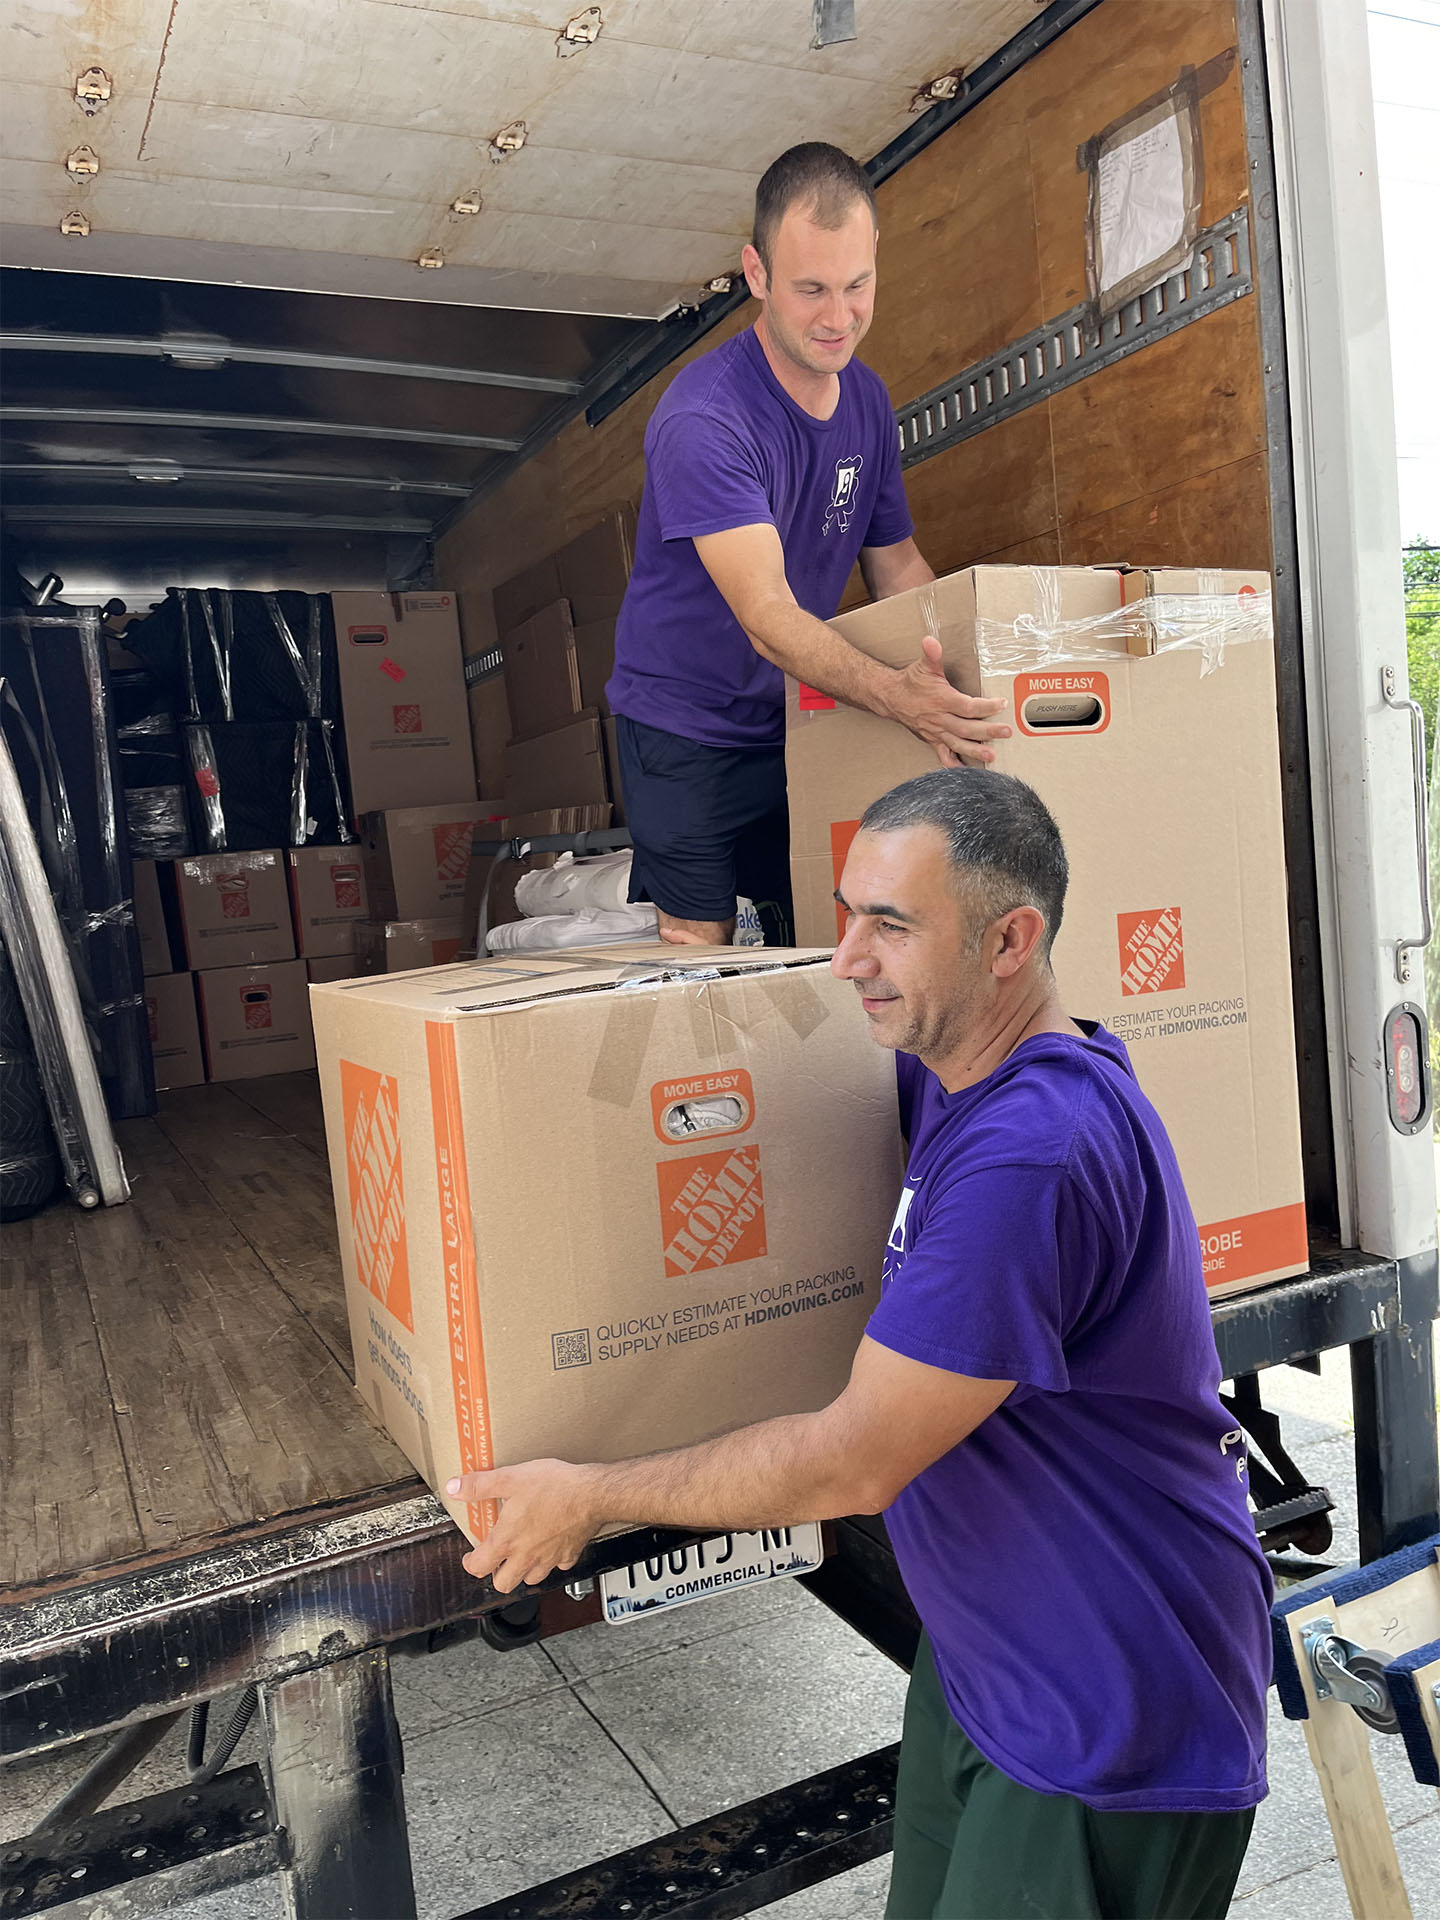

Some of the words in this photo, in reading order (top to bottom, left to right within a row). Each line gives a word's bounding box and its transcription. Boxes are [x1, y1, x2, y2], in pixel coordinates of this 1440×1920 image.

[1029, 677, 1063, 691] MOVE
[1065, 677, 1095, 690] EASY
[1036, 704, 1057, 713] PUSH
[1057, 703, 1079, 712] HERE
[1121, 908, 1182, 994] HOME
[1125, 919, 1151, 955] THE
[1146, 937, 1183, 992] DEPOT
[1112, 1009, 1164, 1028] ESTIMATE
[1166, 1004, 1197, 1019] YOUR
[1199, 997, 1244, 1015] PACKING
[1144, 1025, 1157, 1038] AT
[1159, 1012, 1247, 1036] HDMOVING.COM
[664, 1081, 704, 1098] MOVE
[706, 1075, 740, 1091] EASY
[439, 1146, 460, 1249] LARGE
[664, 1148, 761, 1274] HOME
[670, 1167, 713, 1217] THE
[705, 1186, 764, 1266] DEPOT
[449, 1261, 465, 1362] EXTRA
[596, 1313, 669, 1342] QUICKLY
[673, 1294, 747, 1325] ESTIMATE
[750, 1283, 793, 1306] YOUR
[796, 1266, 856, 1294] PACKING
[598, 1333, 663, 1361] SUPPLY
[666, 1320, 720, 1346] NEEDS
[723, 1314, 741, 1333] AT
[744, 1281, 865, 1326] HDMOVING.COM
[458, 1373, 471, 1440] DUTY
[476, 1397, 485, 1432] LARGE
[665, 1563, 765, 1600] COMMERCIAL
